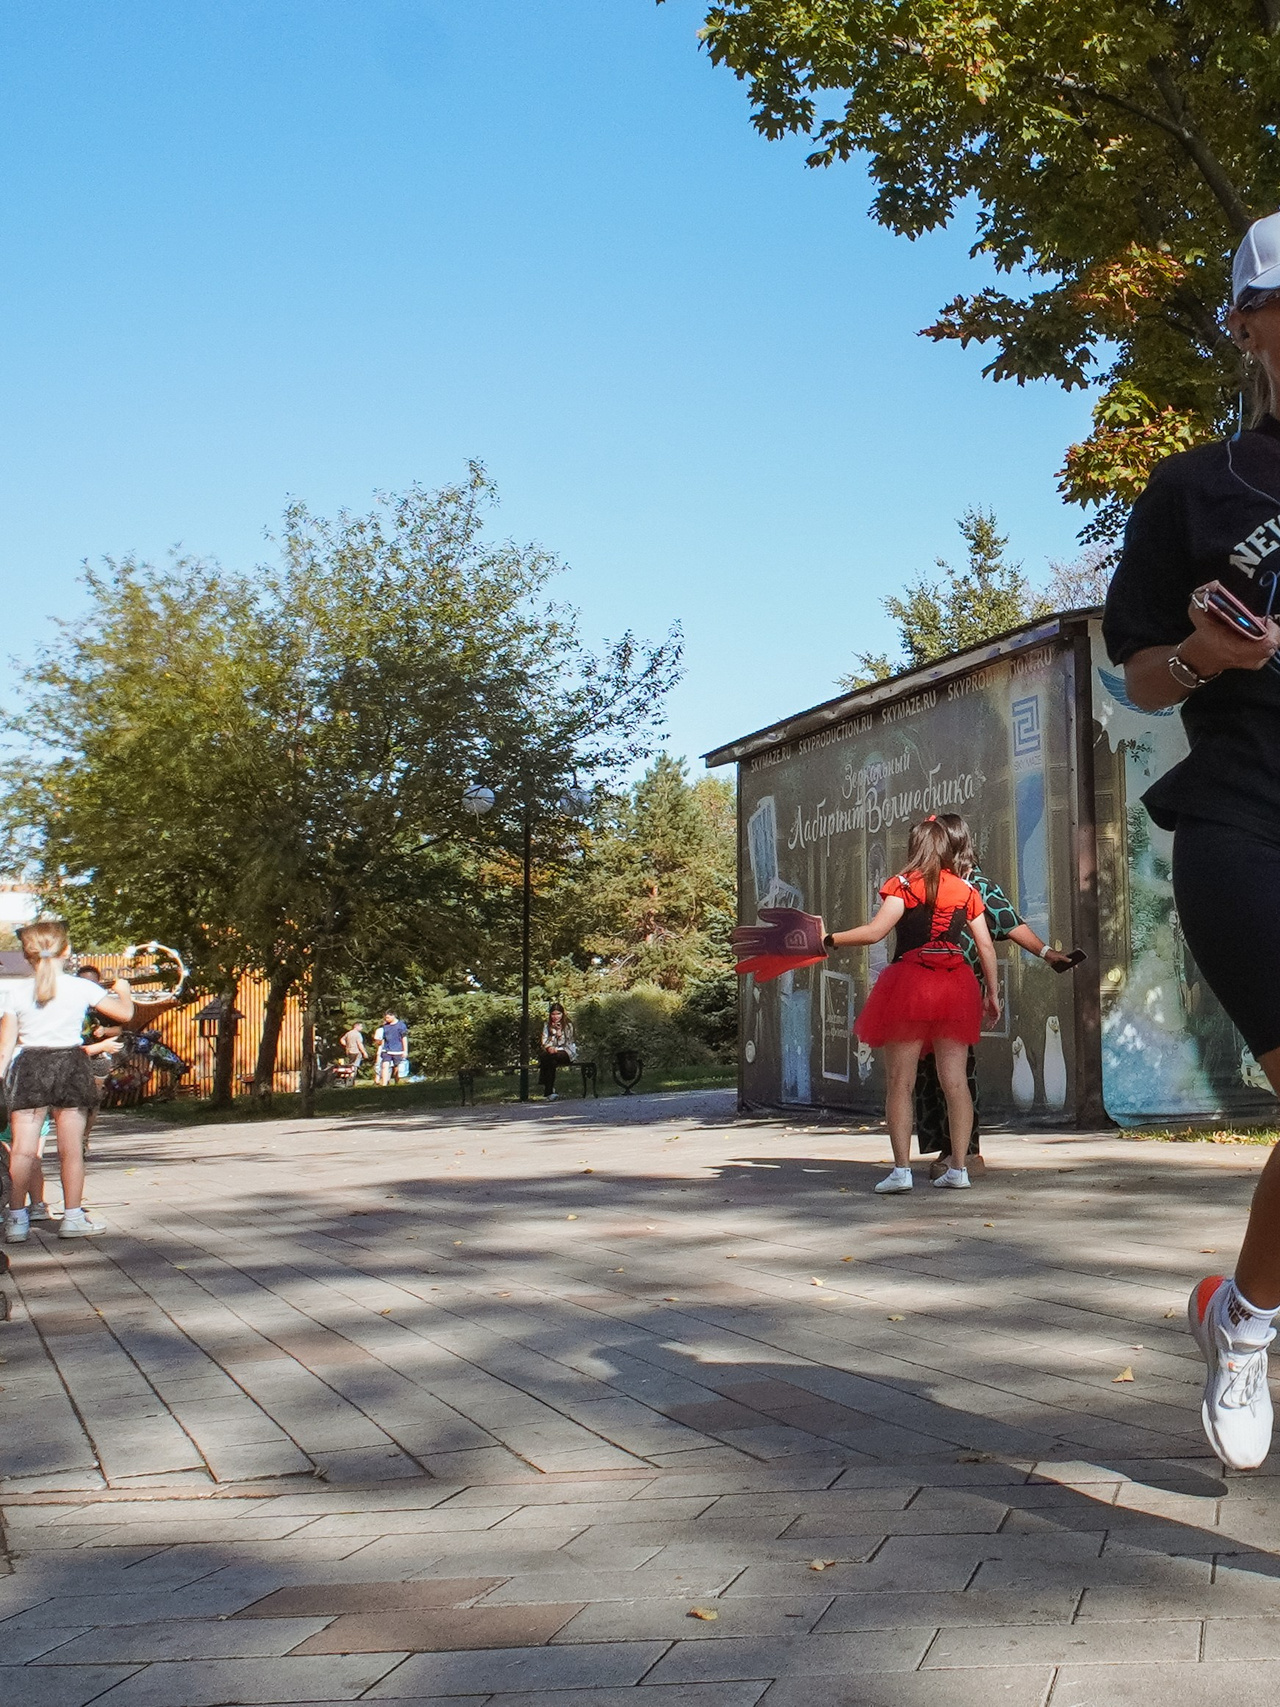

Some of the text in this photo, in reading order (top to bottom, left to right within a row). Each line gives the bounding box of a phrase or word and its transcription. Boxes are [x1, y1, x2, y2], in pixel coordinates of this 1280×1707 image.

[881, 690, 937, 725] SKYMAZE.RU
[787, 763, 975, 858] Лабиринт Волшебника
